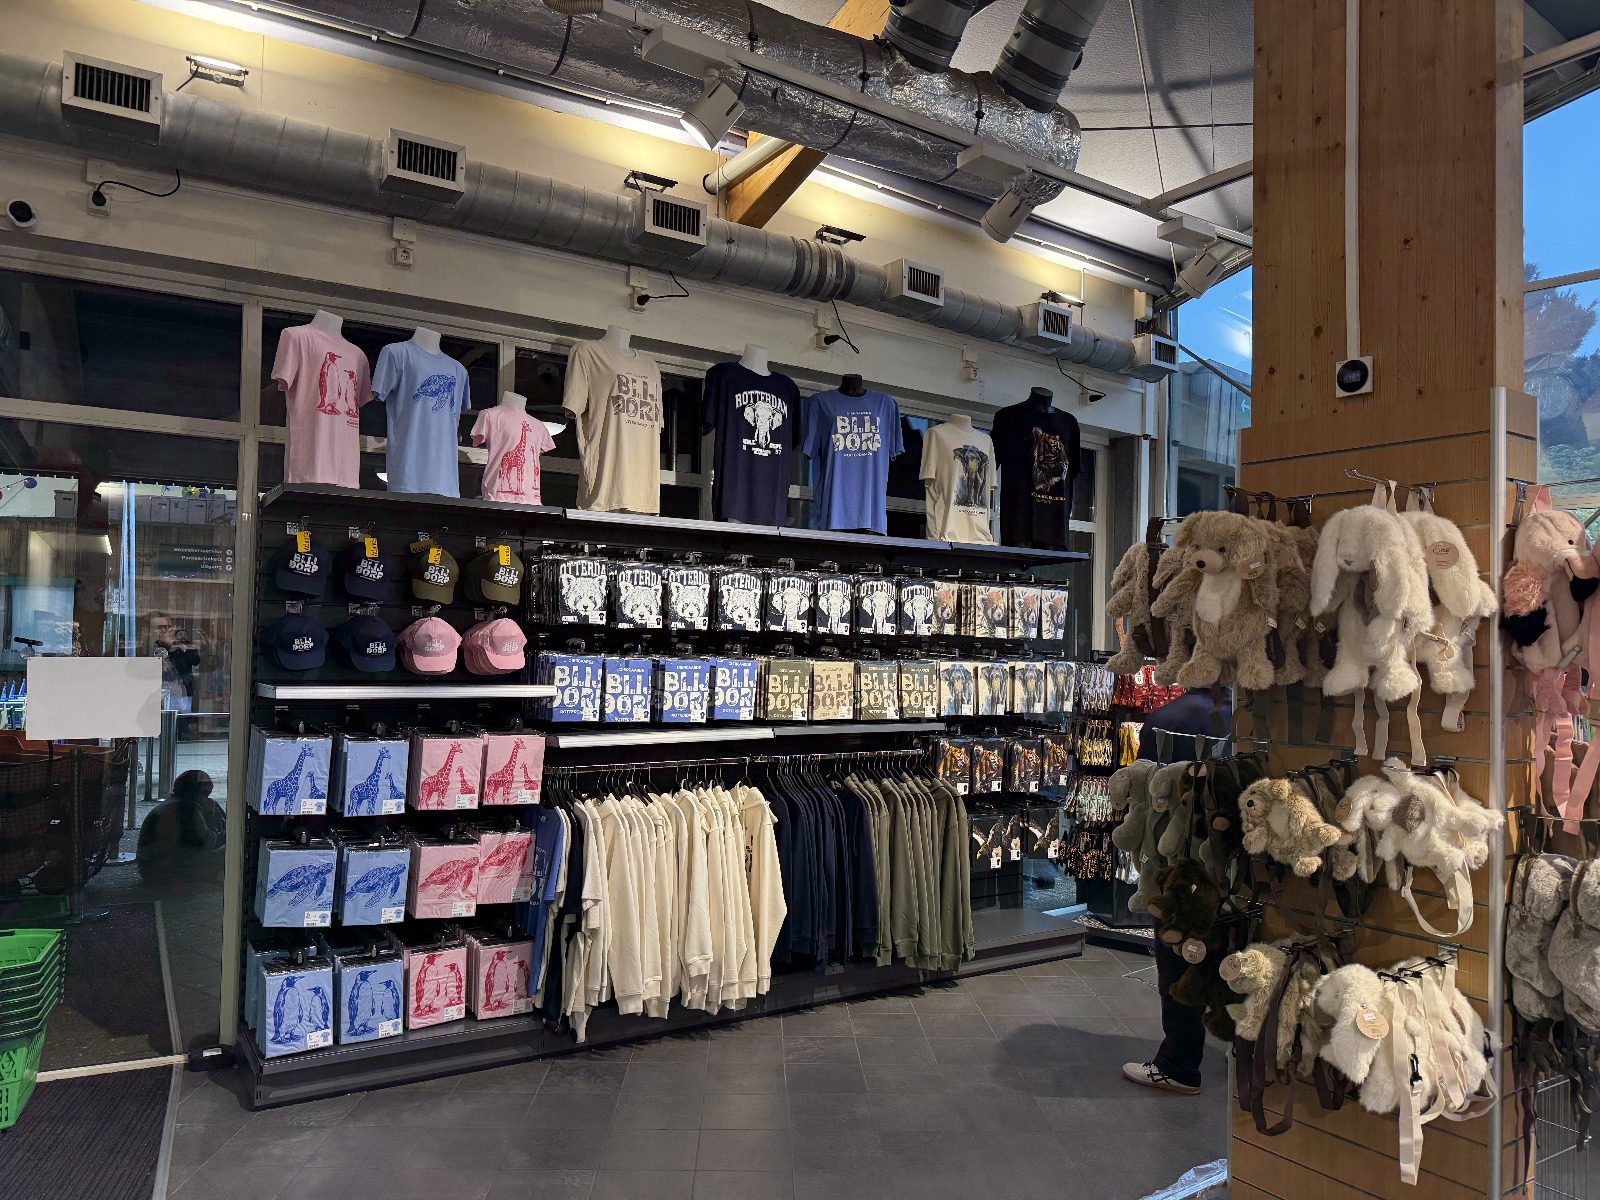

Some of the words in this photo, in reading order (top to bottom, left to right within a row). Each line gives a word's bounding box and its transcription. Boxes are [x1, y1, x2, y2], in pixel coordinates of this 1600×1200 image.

[735, 390, 788, 419] ROTTERDAM
[837, 415, 881, 433] BLIJ
[832, 432, 882, 451] DORP
[560, 560, 606, 576] OTTERDA
[669, 569, 709, 585] OTTERDA
[818, 579, 852, 598] OTTERDA
[861, 580, 896, 599] OTTERDA
[901, 585, 934, 602] OTTERDA
